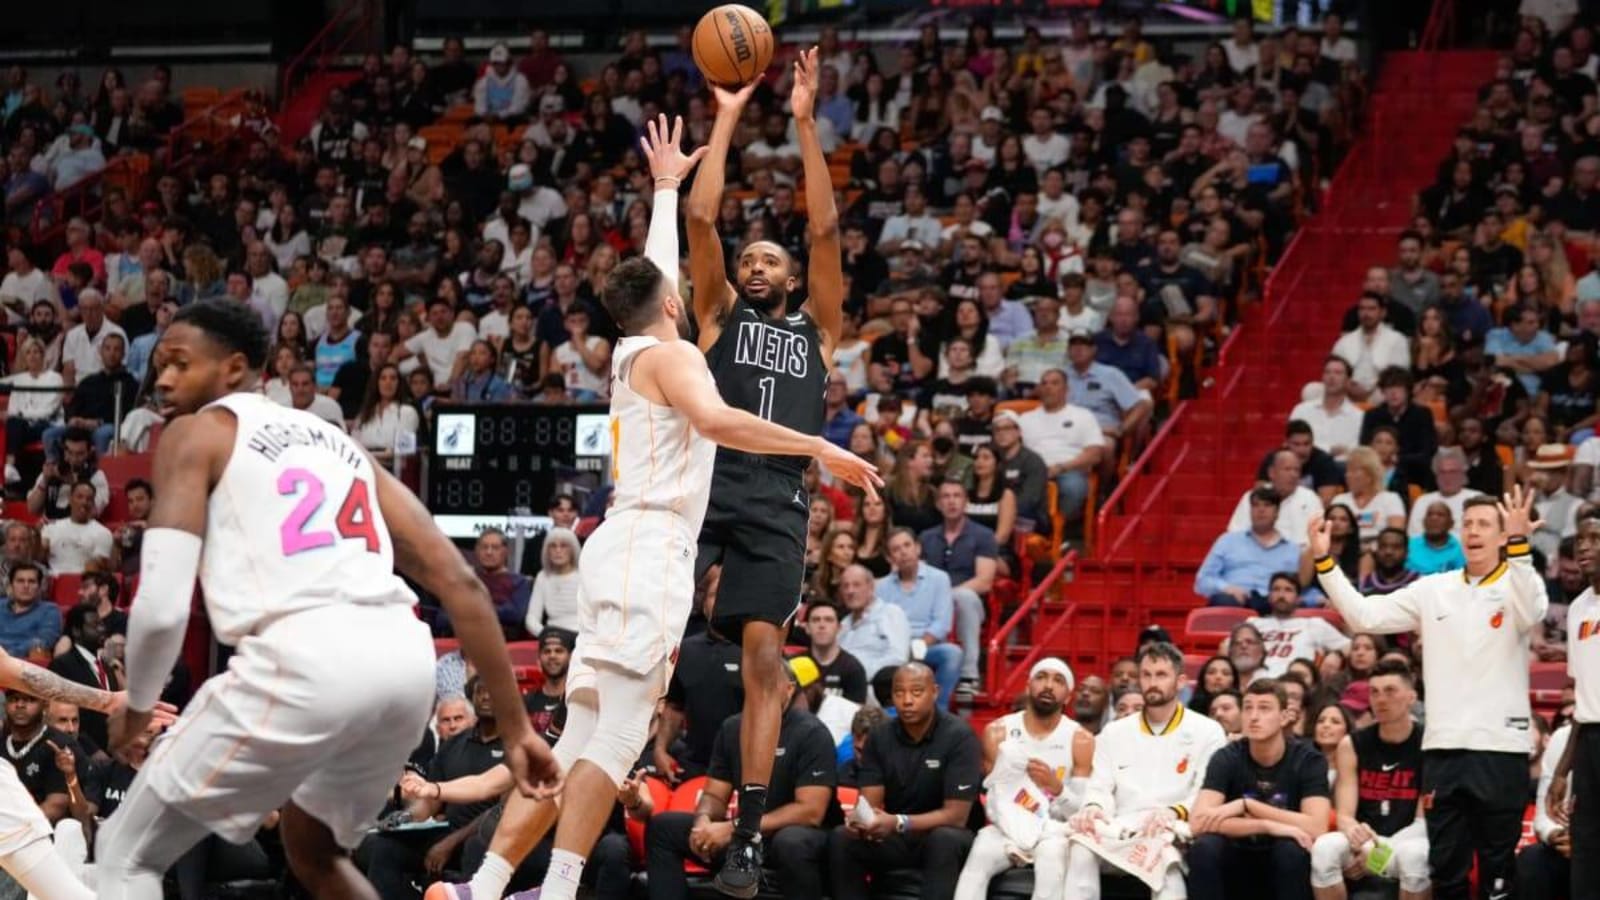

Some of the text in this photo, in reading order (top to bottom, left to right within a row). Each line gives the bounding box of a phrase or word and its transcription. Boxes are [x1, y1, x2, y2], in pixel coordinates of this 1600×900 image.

[735, 322, 808, 378] NETS
[759, 376, 775, 421] 1
[446, 457, 472, 470] HEAT
[277, 467, 381, 557] 24
[1262, 629, 1302, 642] EAT
